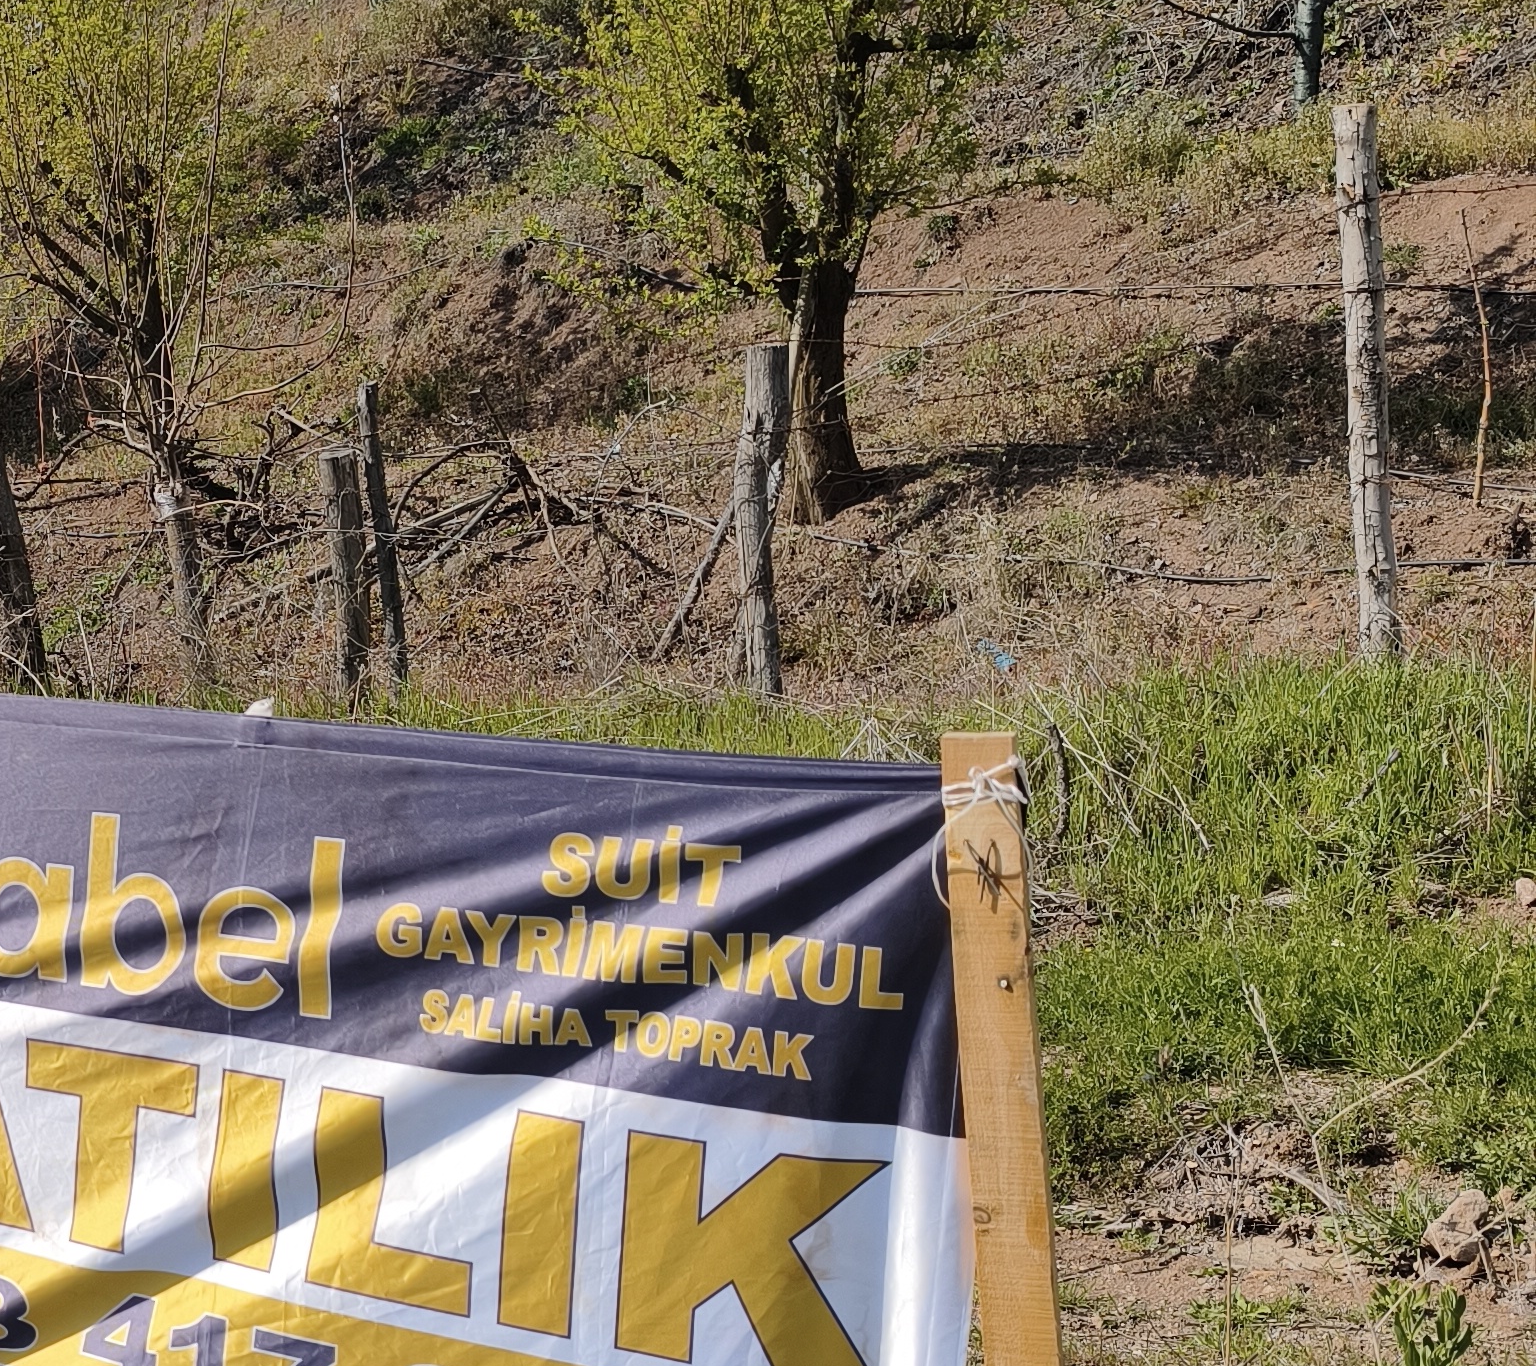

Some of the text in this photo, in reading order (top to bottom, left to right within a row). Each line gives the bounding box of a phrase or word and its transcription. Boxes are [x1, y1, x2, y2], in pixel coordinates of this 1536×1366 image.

[542, 825, 742, 907] SUİT
[376, 902, 904, 1010] GAYRİMENKUL
[419, 989, 814, 1081] SALİHA TOPRAK
